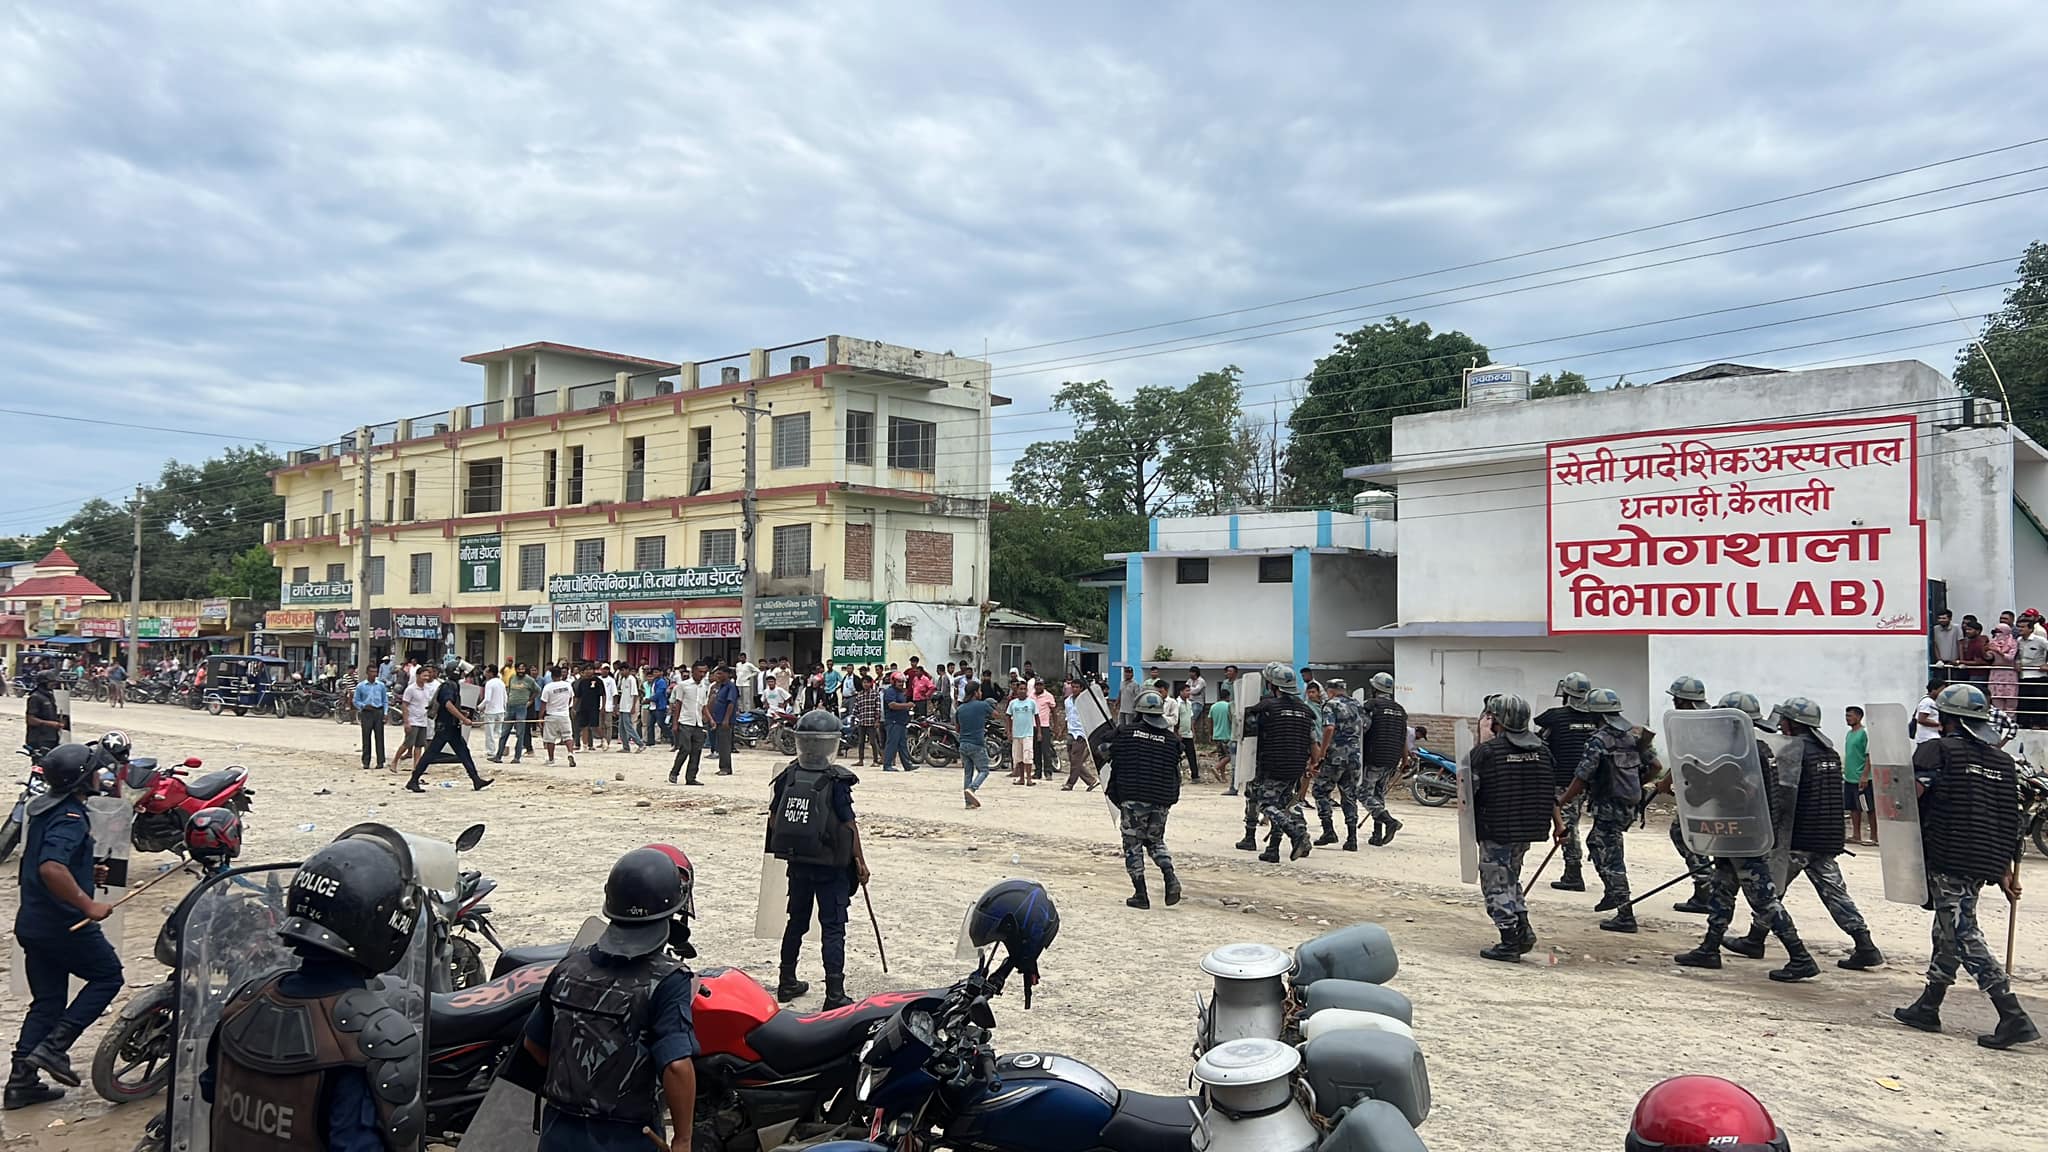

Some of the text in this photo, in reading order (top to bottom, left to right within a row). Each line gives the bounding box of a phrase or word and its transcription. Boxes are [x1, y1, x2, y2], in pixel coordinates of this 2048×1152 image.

[1556, 438, 1905, 485] सेती प्रादेशिक अस्पताल
[1555, 524, 1891, 577] प्रयोगशाला
[292, 583, 329, 597] गरिमा
[550, 576, 572, 593] गरिमा
[572, 573, 628, 592] पोलिक्लिनिक
[656, 575, 677, 589] तथा
[678, 570, 708, 587] गरिमा
[345, 616, 360, 627] SQUA
[848, 610, 878, 625] गरिमा
[1700, 821, 1743, 835] A.P.F.
[294, 870, 340, 898] POLICE
[222, 1083, 295, 1140] POLICE
